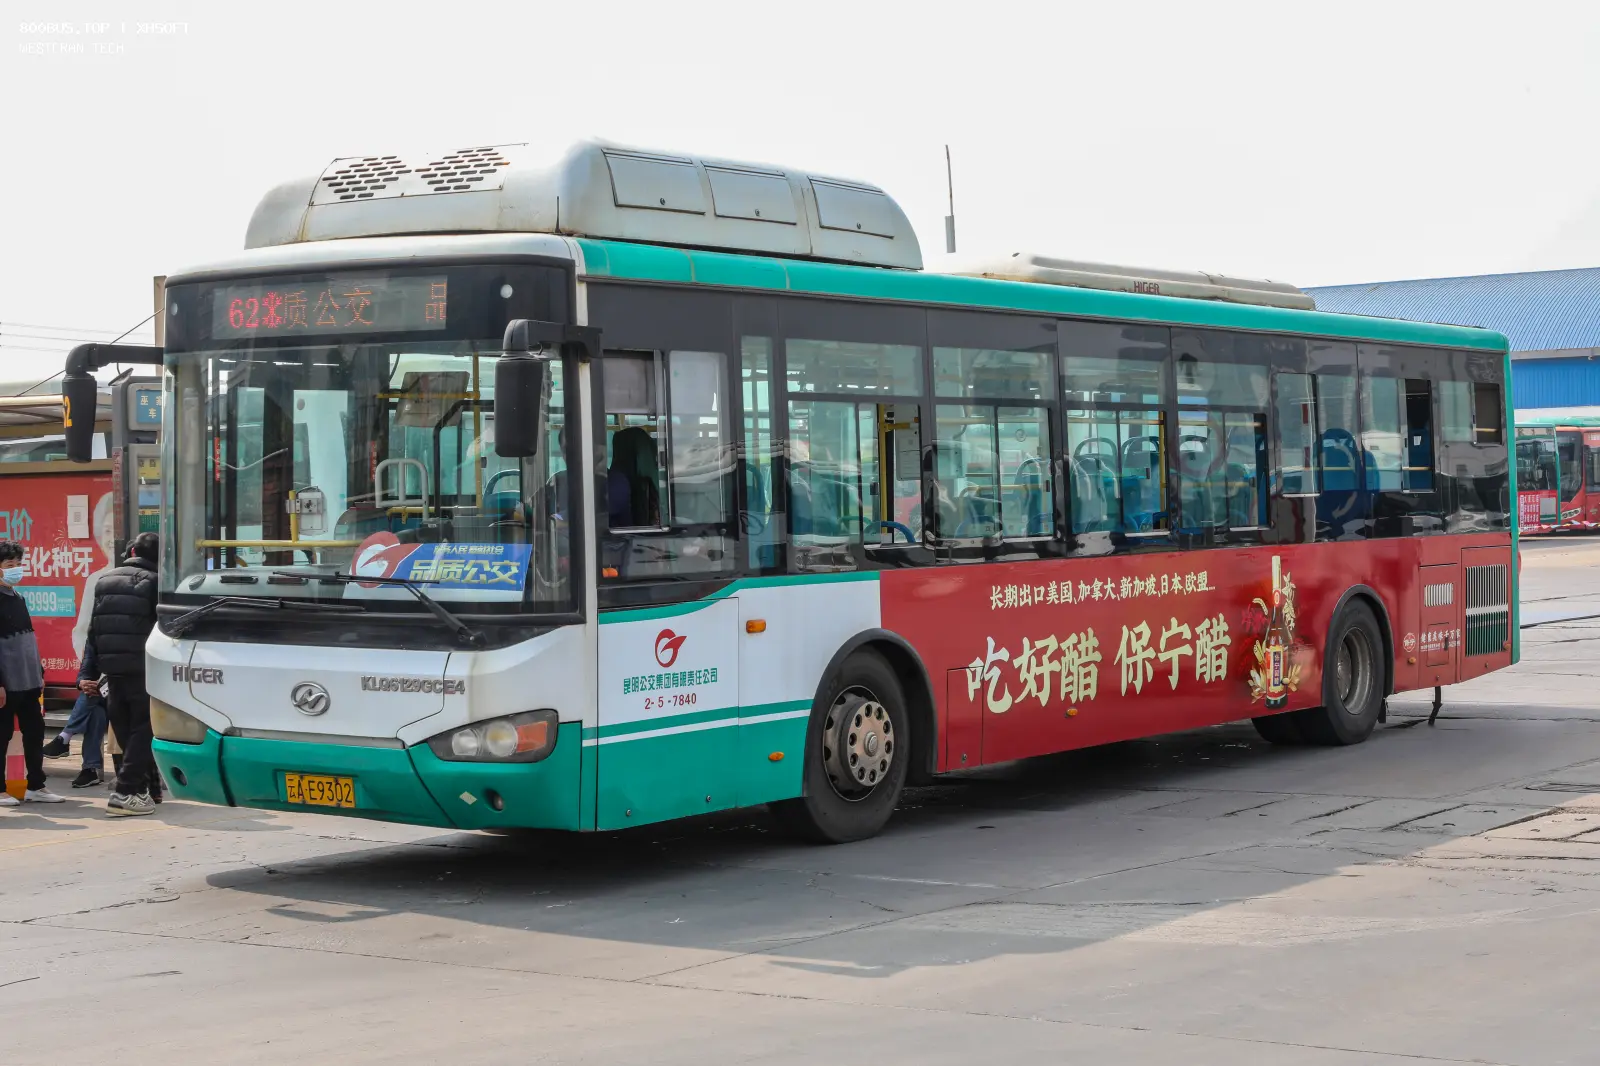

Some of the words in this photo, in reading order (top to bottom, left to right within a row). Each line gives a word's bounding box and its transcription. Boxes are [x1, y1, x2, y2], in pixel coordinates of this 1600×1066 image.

[1133, 281, 1160, 295] HIGER
[409, 559, 520, 584] 品质公交
[966, 627, 1103, 714] 吃好醋
[1113, 613, 1232, 697] 保宁醋
[172, 665, 224, 685] HIGER
[360, 675, 466, 695] KLQ6129GCE4
[623, 667, 718, 695] 昆明公交集团有限责任公司
